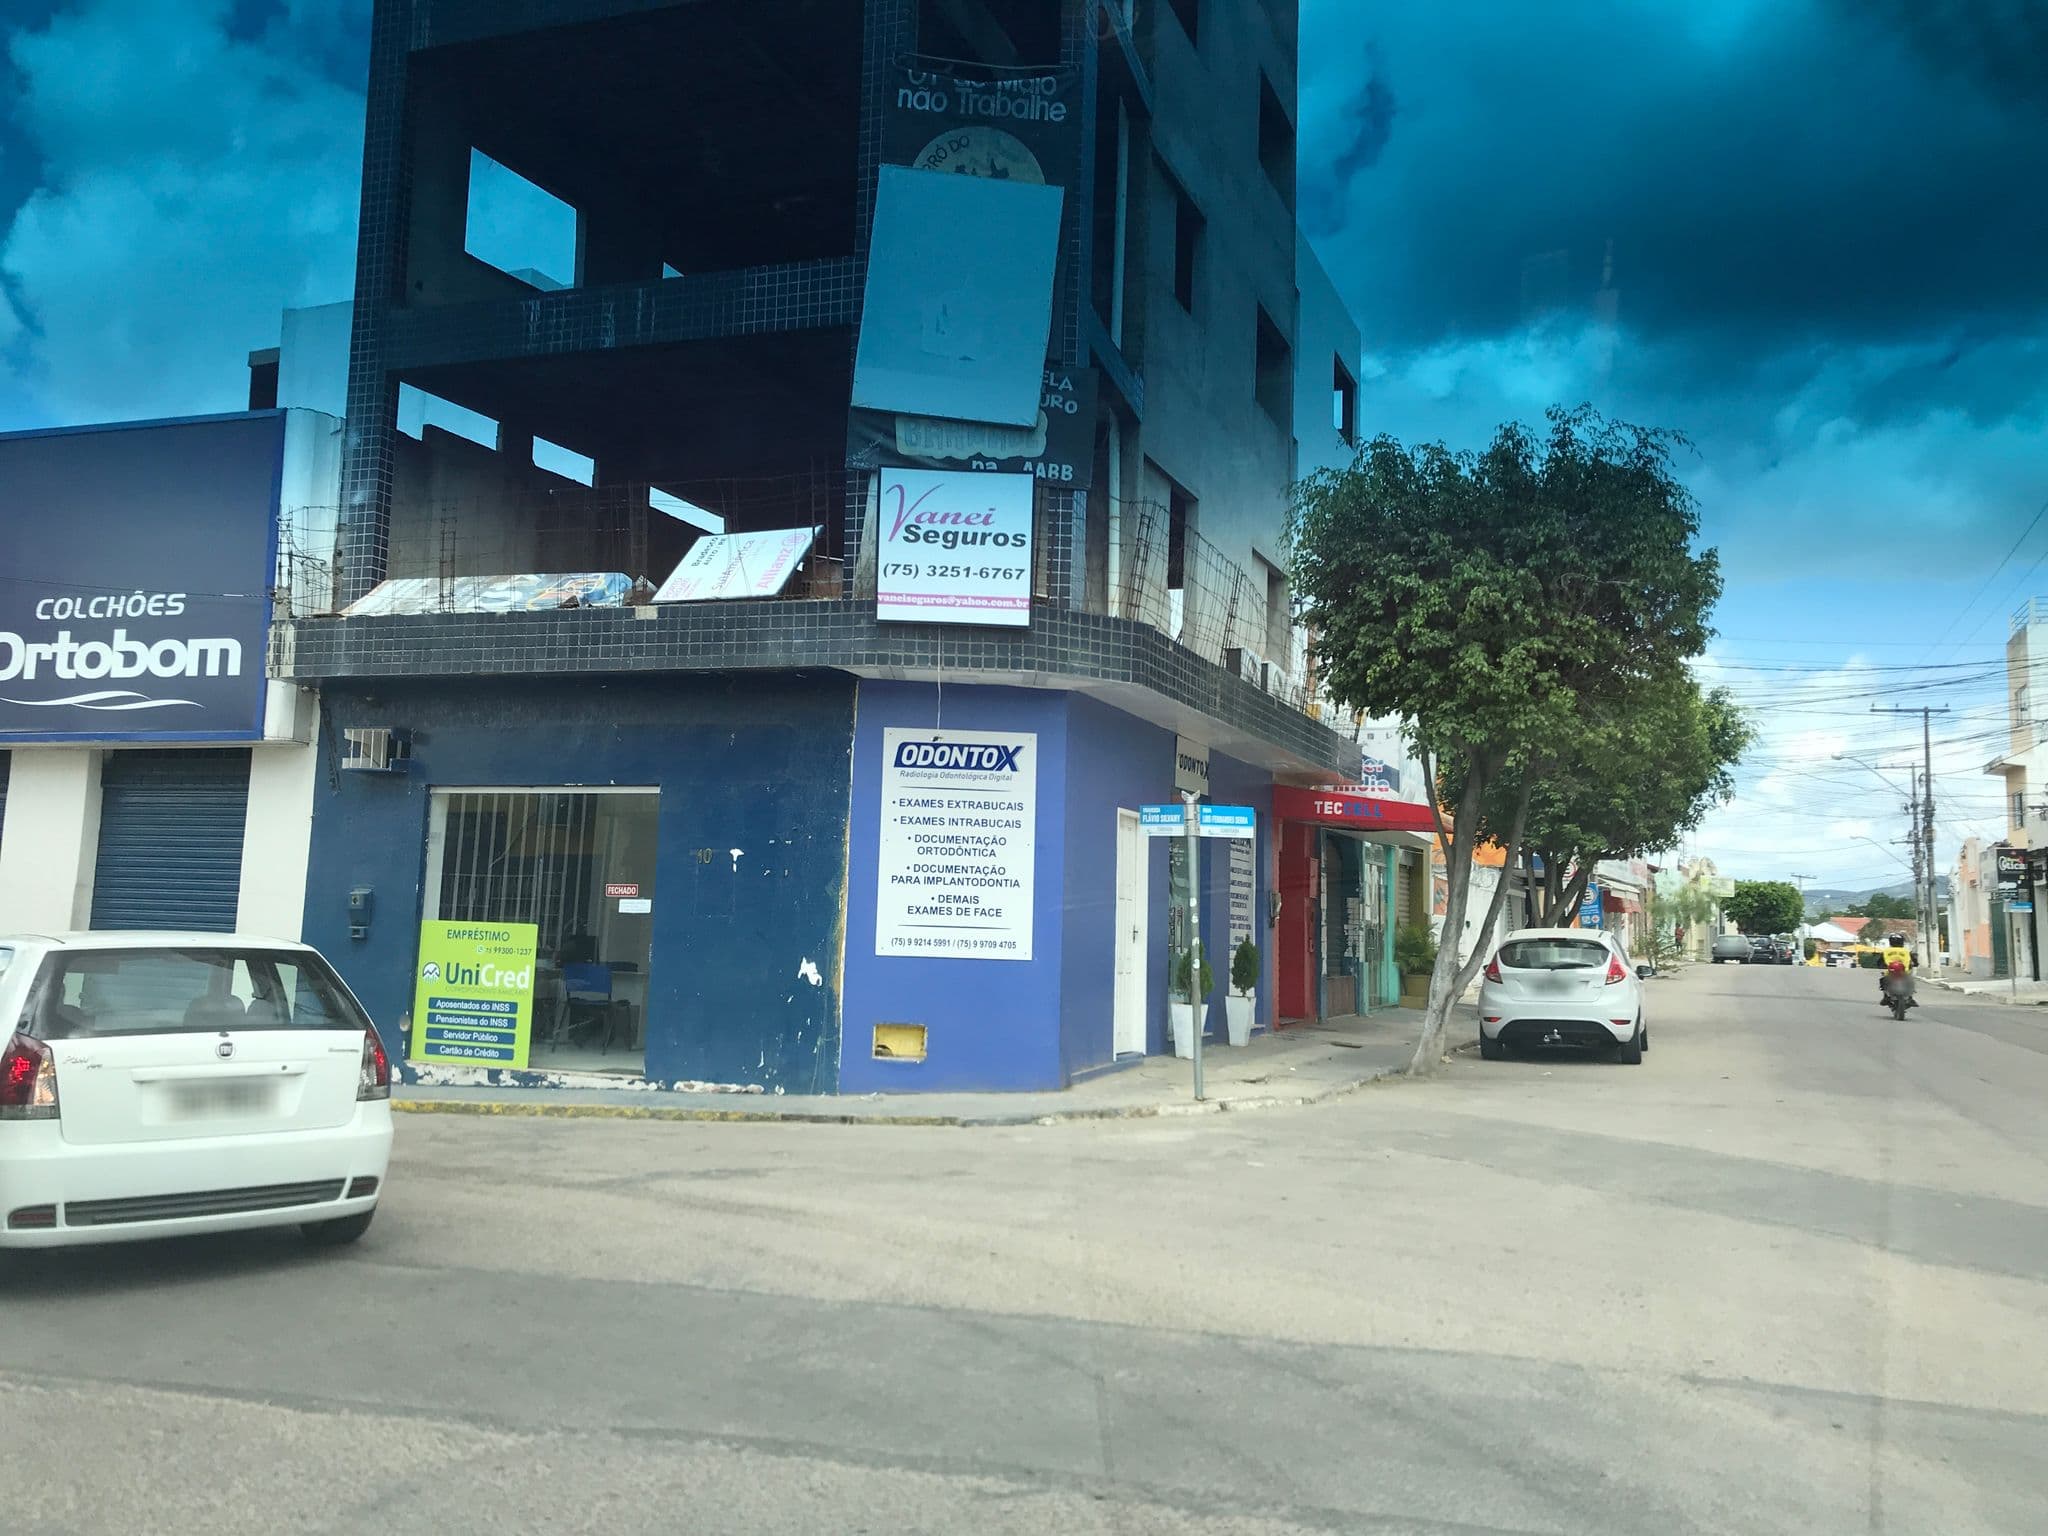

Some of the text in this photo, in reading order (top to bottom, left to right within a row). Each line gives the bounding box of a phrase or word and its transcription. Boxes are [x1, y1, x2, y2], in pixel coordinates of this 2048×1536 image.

[898, 87, 1067, 122] não Trabalhe
[949, 135, 970, 152] DO
[972, 460, 997, 470] na
[886, 483, 996, 542] Vanei
[903, 524, 1026, 549] Seguros
[883, 563, 1025, 580] (75) 3251-6767
[36, 590, 186, 619] COLCHÕES
[0, 628, 242, 682] Ortobom
[900, 743, 1024, 771] ODONTOX
[900, 769, 1012, 782] Radiologia Odontológica Digital
[899, 798, 1024, 811] EXAMES EXTRABUCAIS
[900, 816, 1022, 828] EXAMES INTRABUCAIS
[914, 834, 1007, 847] DOCUMENTAÇÃO
[917, 846, 997, 857] ORTODÔNTICA
[913, 864, 1006, 876] DOCUMENTAÇÃO
[891, 875, 1020, 888] PARA IMPLANTODONTIA
[608, 886, 636, 895] FECHADO
[938, 894, 980, 904] DEMAIS
[907, 905, 1002, 917] EXAMES DE FACE
[447, 927, 510, 942] EMPRÉSTIMO
[891, 938, 906, 947] (75)
[907, 938, 912, 946] 9
[914, 938, 932, 947] 9214
[933, 939, 951, 947] 5991
[957, 939, 972, 949] (75)
[973, 940, 978, 948] 9
[980, 940, 997, 949] 9709
[999, 941, 1017, 949] 4705
[446, 962, 531, 989] UniCred
[436, 1000, 510, 1012] Aposentados do INSS
[436, 1014, 508, 1027] Pensionistas do INSS
[443, 1030, 498, 1042] Servidor Público
[440, 1045, 499, 1058] Cartão de Crédito
